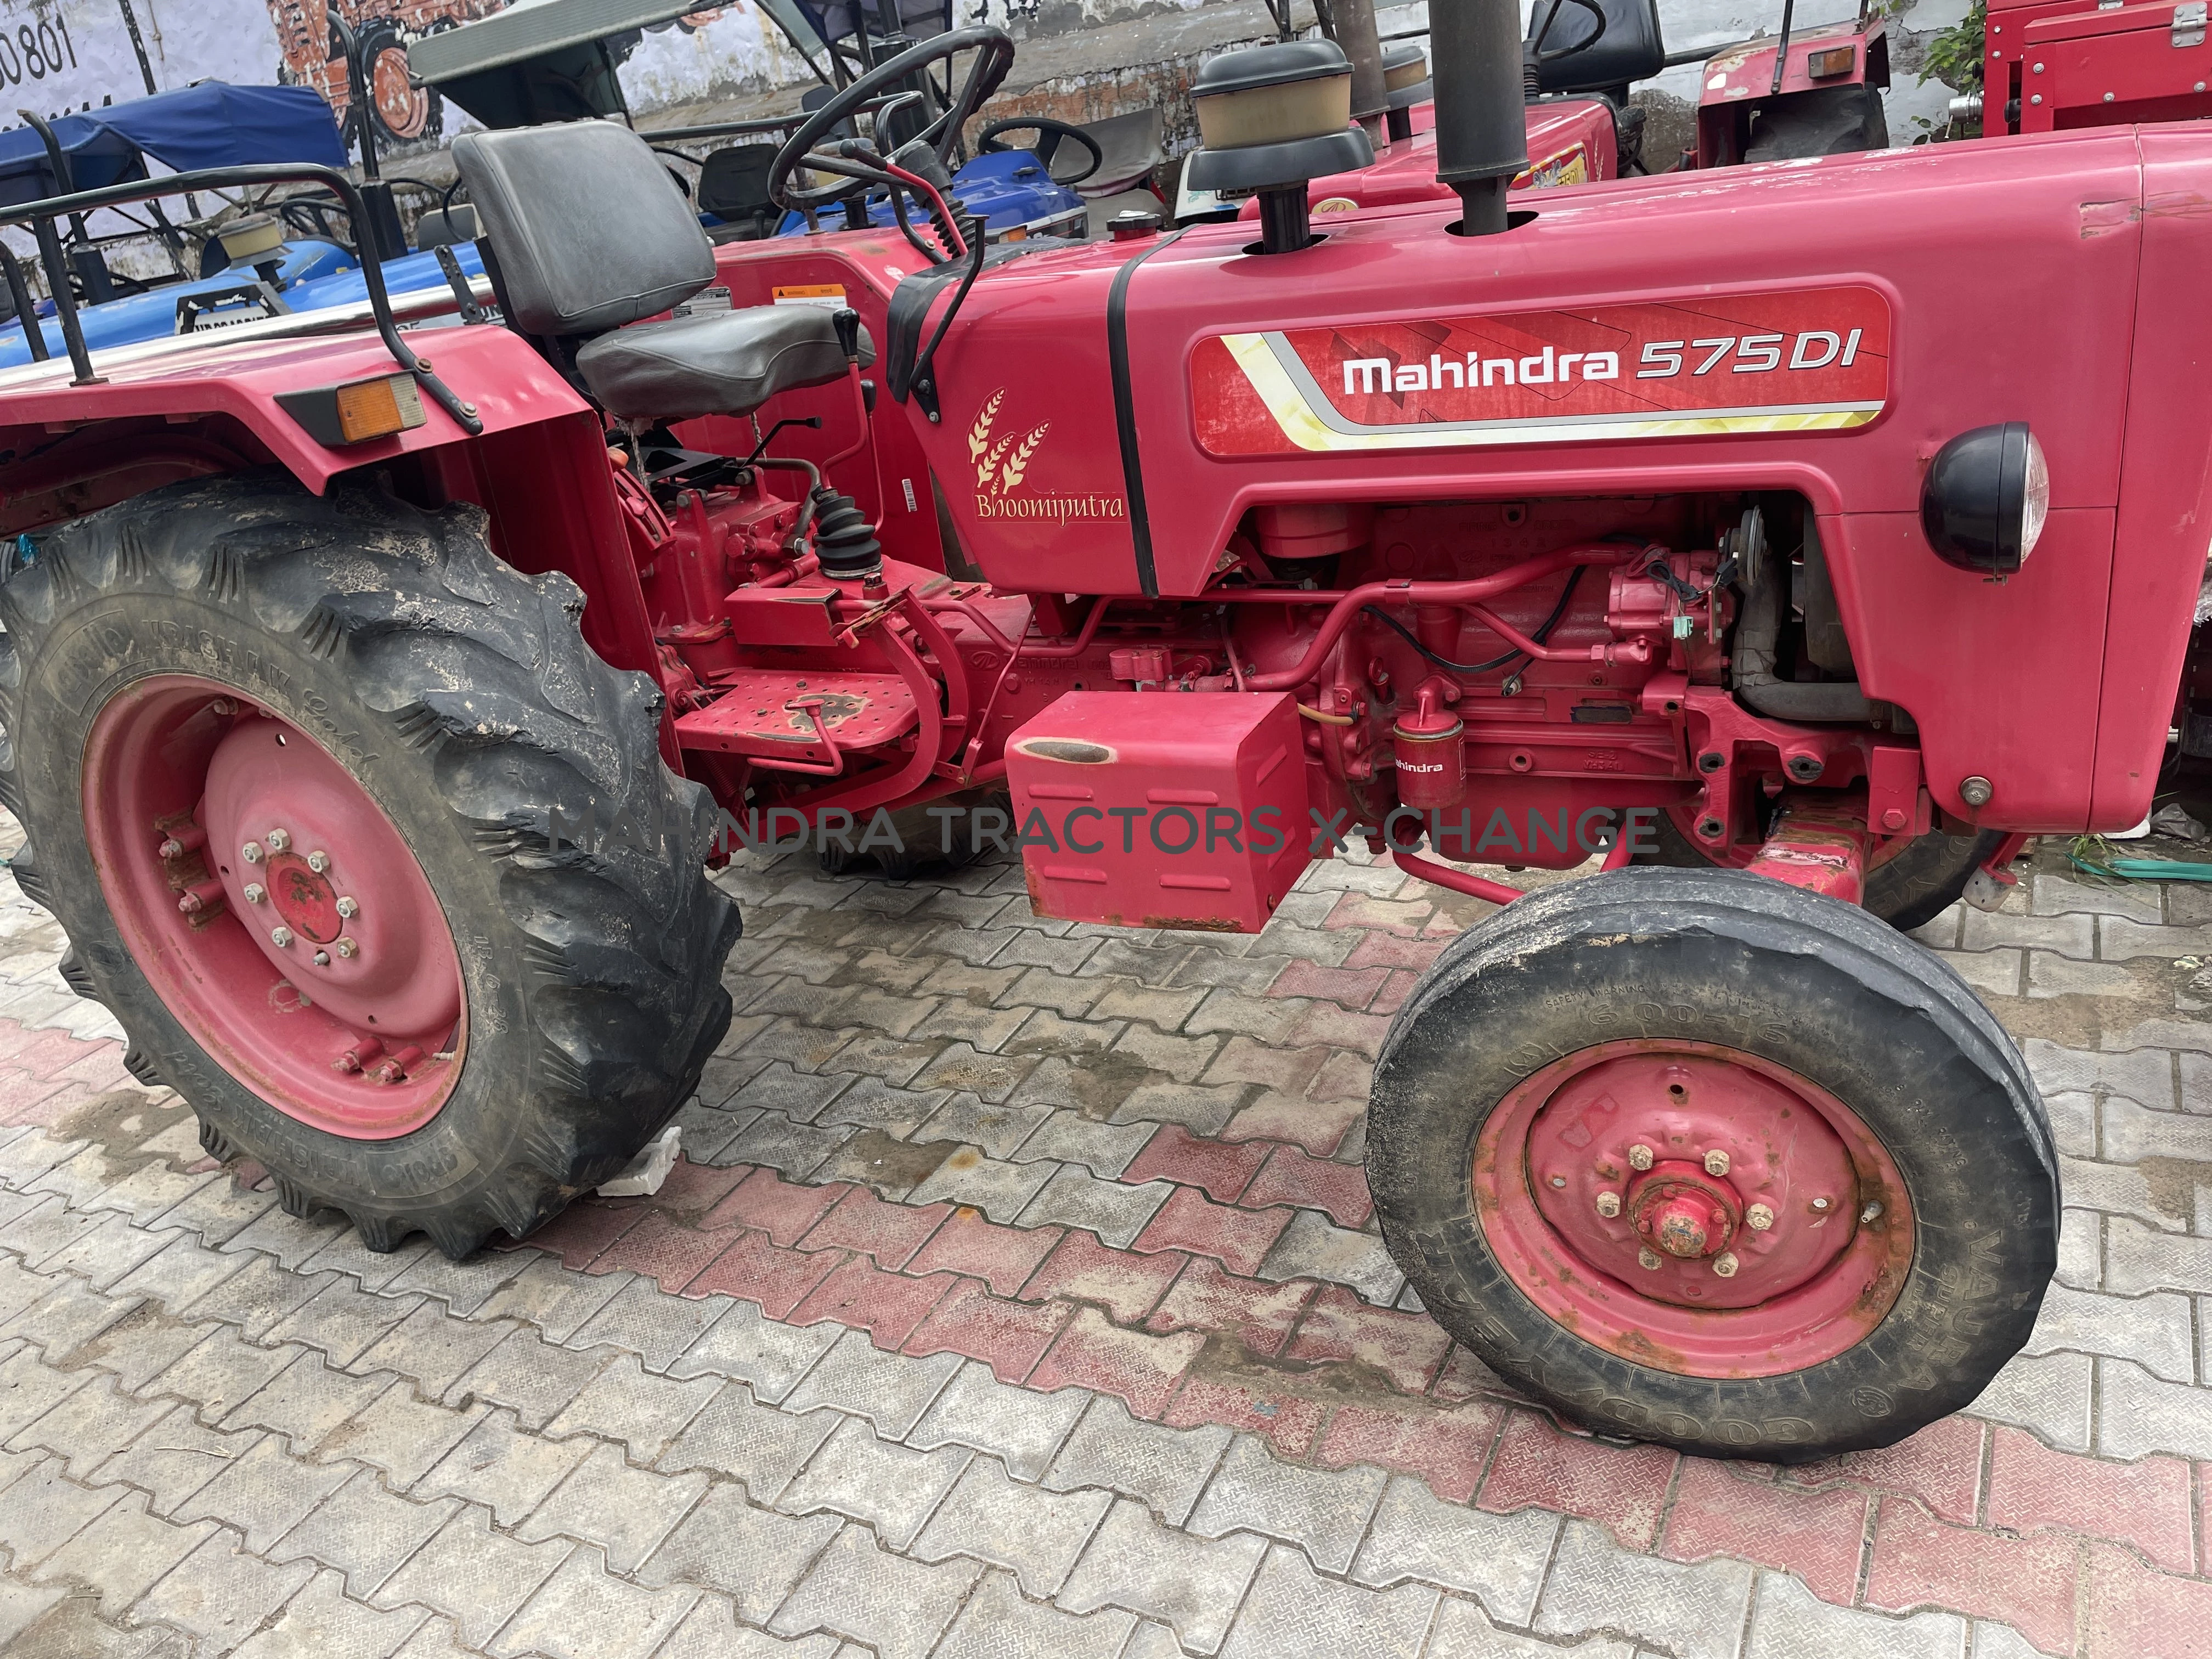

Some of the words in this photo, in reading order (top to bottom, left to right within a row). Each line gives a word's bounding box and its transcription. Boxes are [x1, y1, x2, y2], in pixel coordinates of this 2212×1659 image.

[0, 13, 77, 91] 0801
[1343, 345, 1620, 395] Mahindra
[1636, 328, 1864, 380] 575DI
[974, 490, 1124, 527] Bhoomiputra
[1395, 759, 1443, 773] ahindra
[1415, 1232, 1815, 1446] GOODYEAR
[1897, 1229, 2003, 1392] VAJRA
[1905, 1263, 1962, 1353] SUPER
